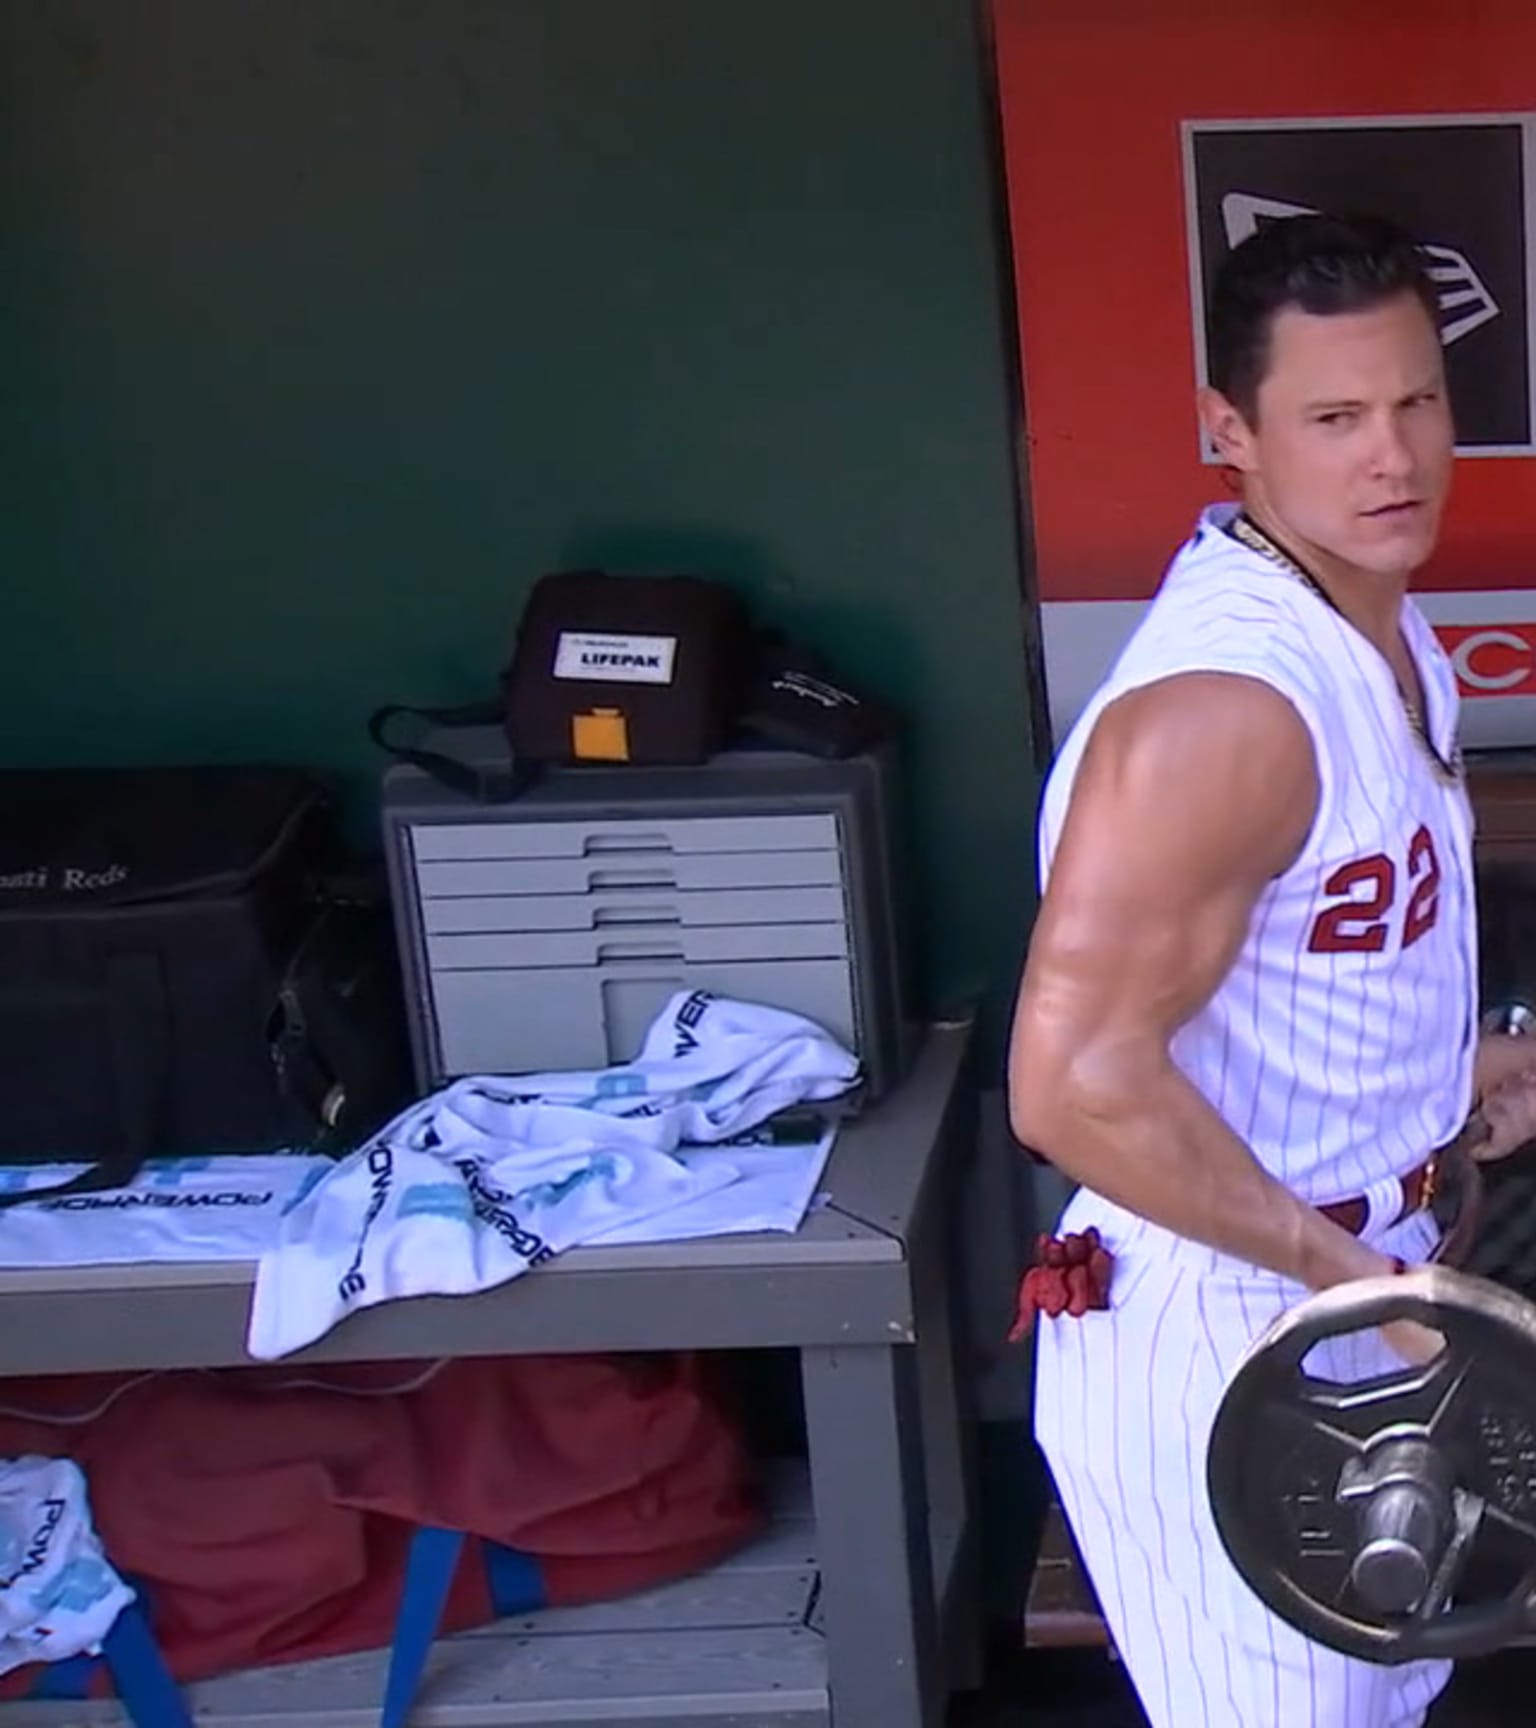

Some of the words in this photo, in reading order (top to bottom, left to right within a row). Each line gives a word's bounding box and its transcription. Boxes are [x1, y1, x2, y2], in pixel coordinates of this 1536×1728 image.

[580, 652, 661, 668] LIFEPAK
[63, 864, 128, 891] Reds
[1308, 823, 1441, 953] 22
